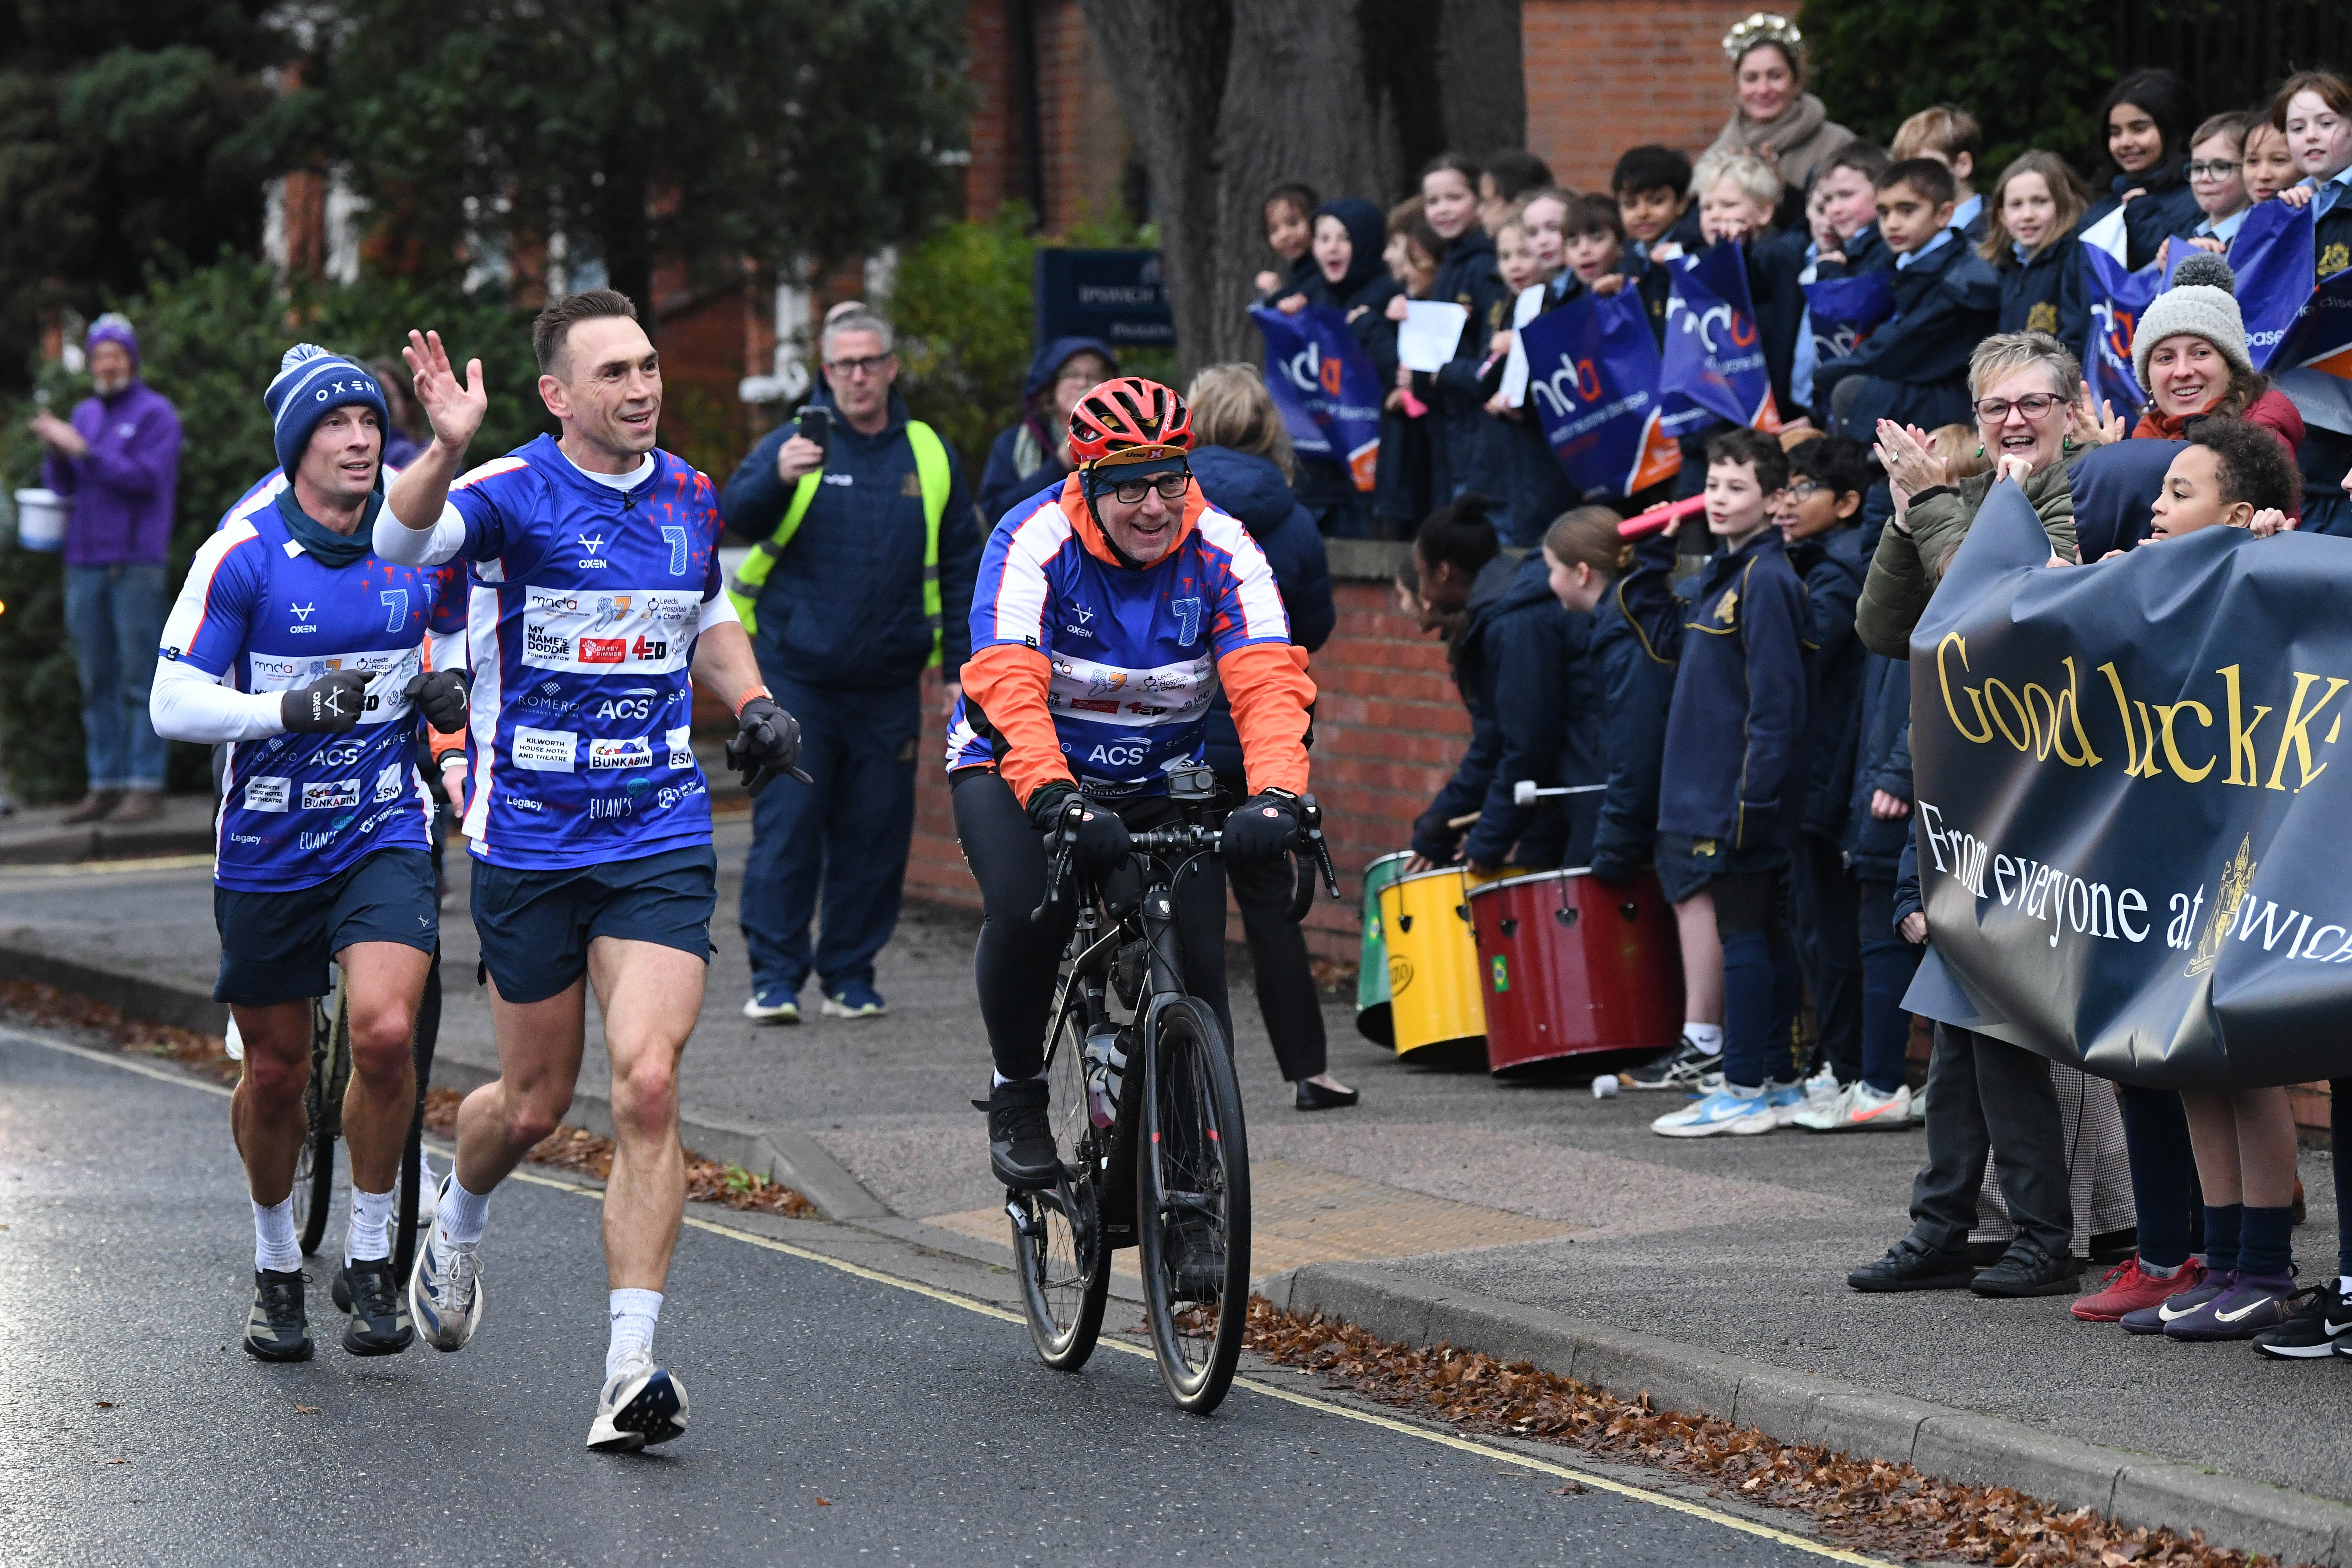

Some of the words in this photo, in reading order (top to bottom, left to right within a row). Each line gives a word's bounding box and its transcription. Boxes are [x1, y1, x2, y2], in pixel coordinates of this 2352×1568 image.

[316, 380, 375, 401] OXEN
[578, 559, 607, 568] OXEN
[533, 596, 577, 610] mnda
[290, 625, 316, 633] OXEN
[529, 624, 545, 634] MY
[1066, 625, 1093, 638] OXEN
[528, 633, 568, 646] NAME'S
[528, 642, 570, 654] DODDIE
[527, 651, 569, 661] FOUNDATION
[255, 661, 293, 674] mnda
[1157, 672, 1174, 681] Leeds
[1160, 675, 1188, 687] Hospitals
[1160, 683, 1186, 691] Charity
[312, 691, 321, 721] OXEN
[518, 695, 580, 712] ROMERO
[596, 699, 649, 719] ACS
[1937, 632, 2103, 767] Good
[2097, 661, 2273, 787] luck
[518, 707, 551, 716] INSURANCE
[526, 737, 565, 747] KILWORTH
[309, 748, 358, 766] ACS
[1088, 744, 1144, 765] ACS
[376, 786, 400, 799] ESM
[506, 794, 543, 811] Legacy
[590, 797, 633, 819] EUAN'S
[231, 832, 261, 845] Legacy
[1918, 800, 1988, 898] From
[1994, 854, 2150, 948] everyone
[2166, 883, 2204, 951] at
